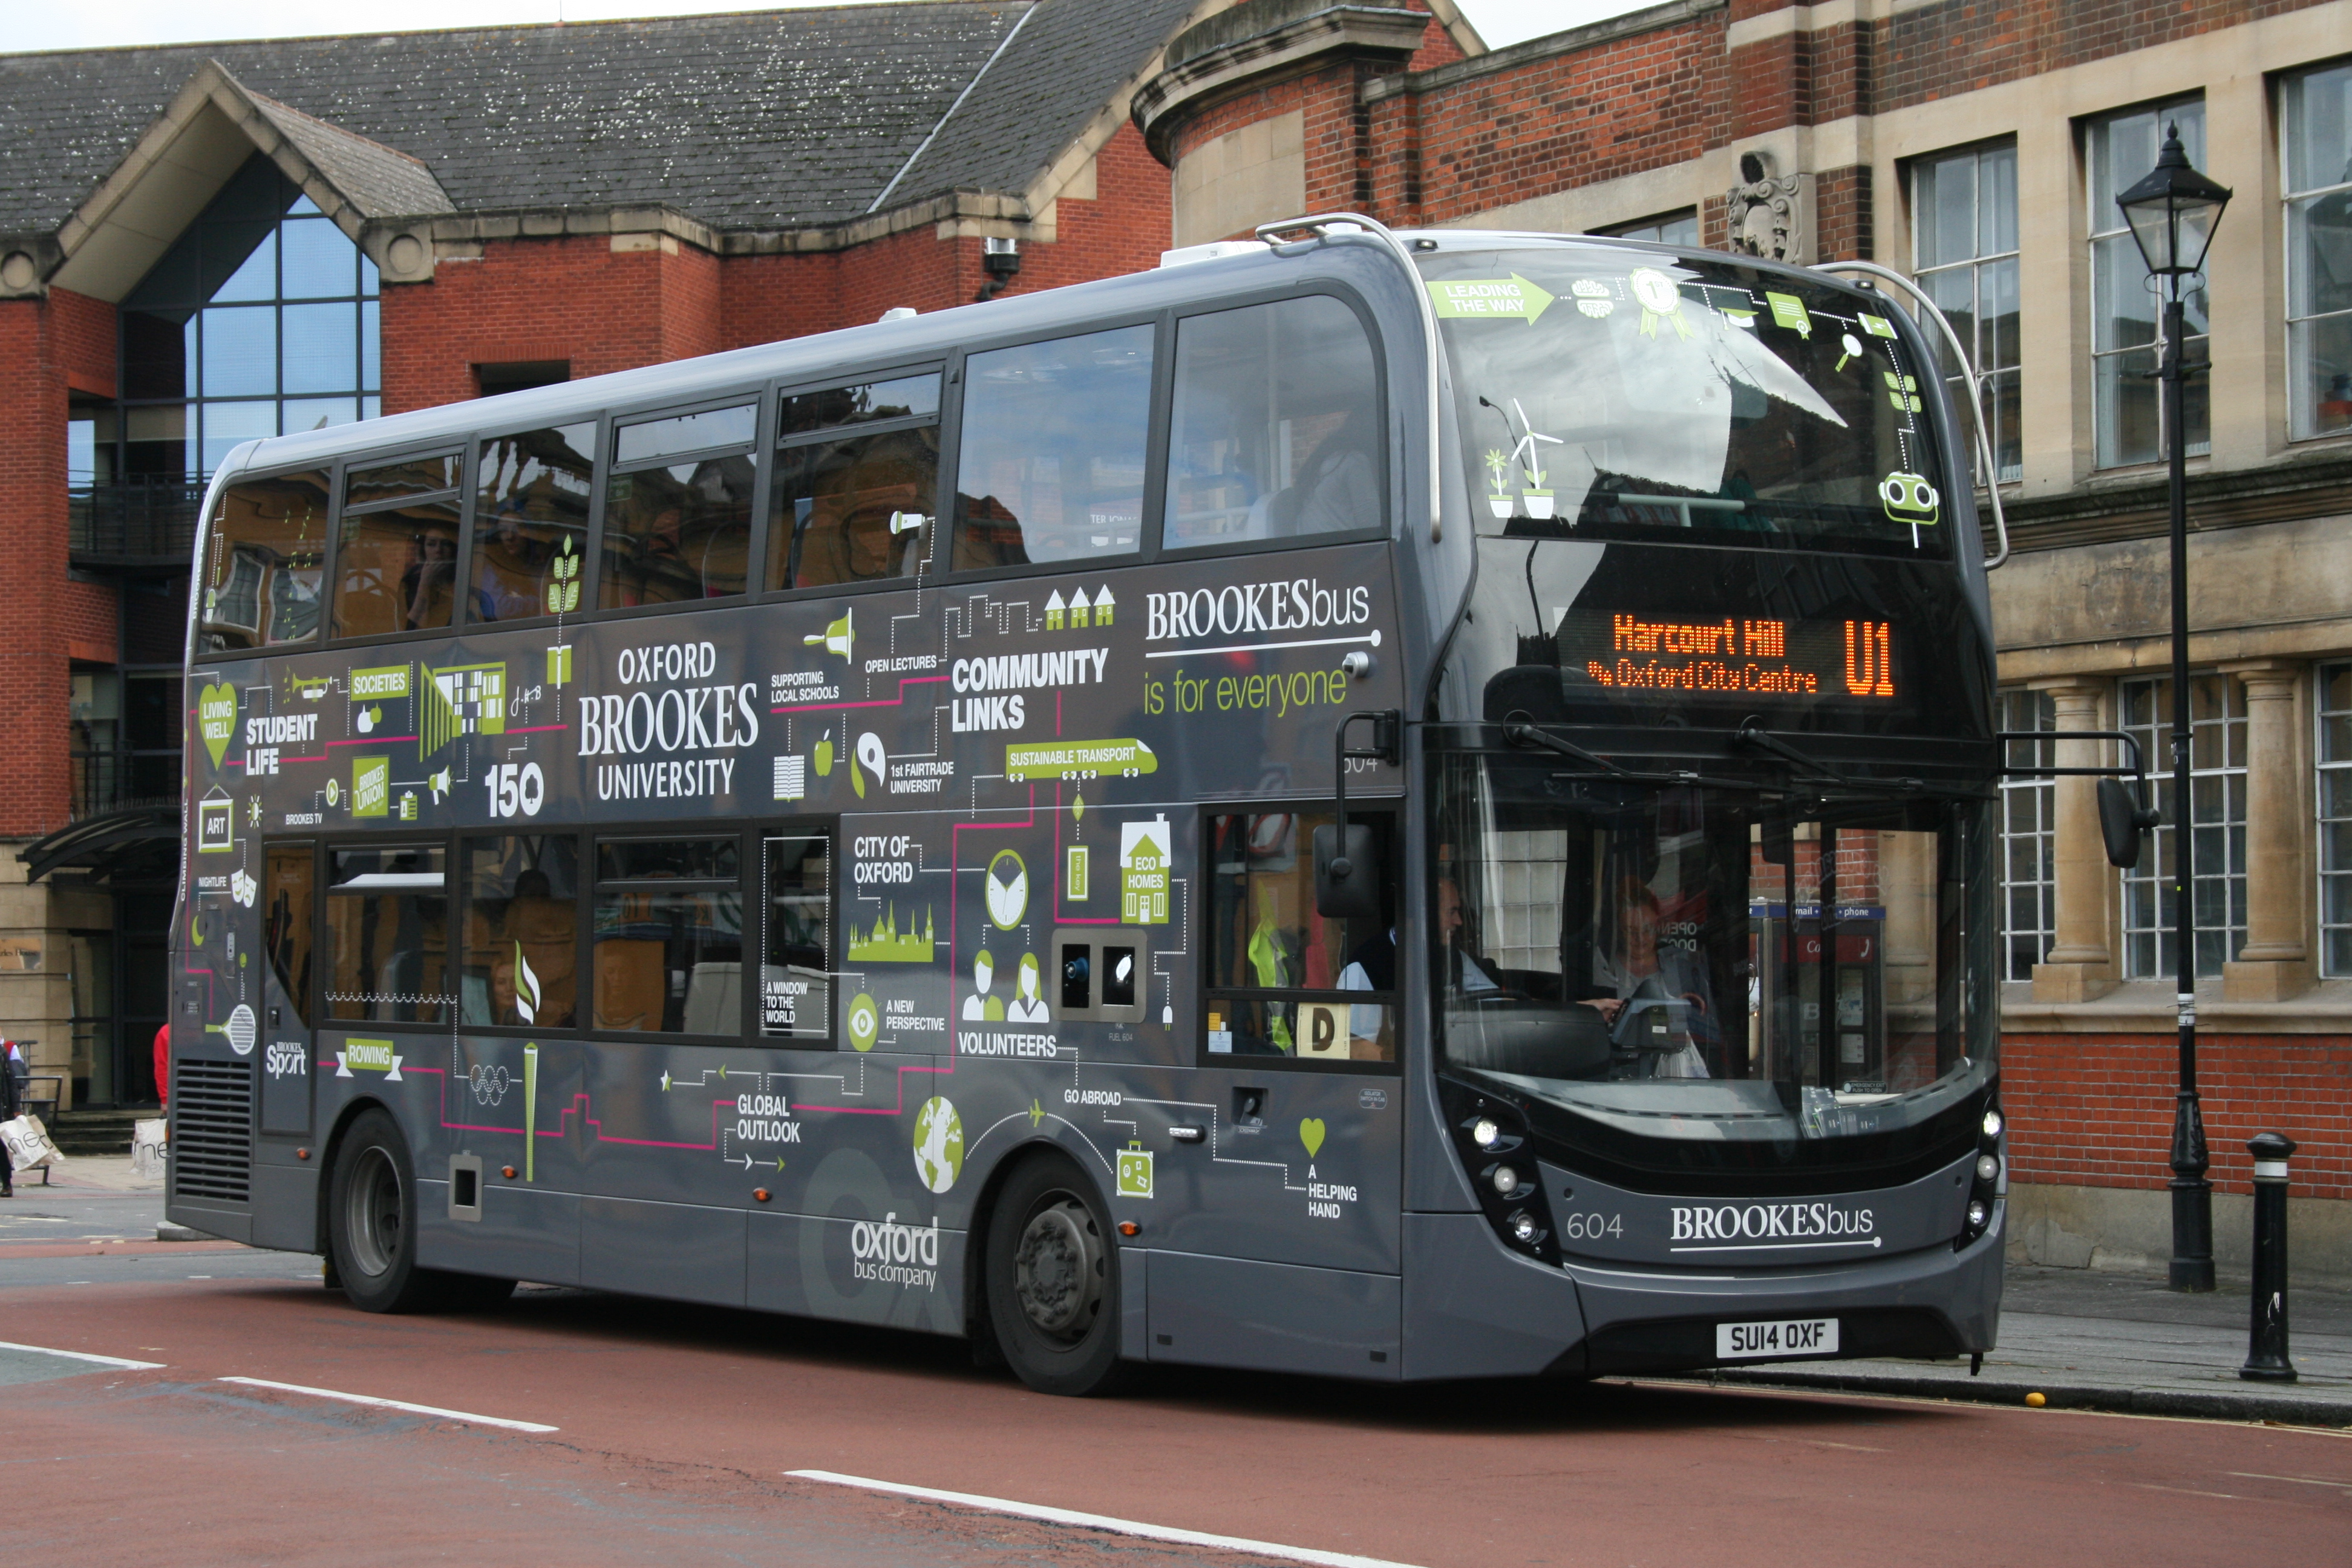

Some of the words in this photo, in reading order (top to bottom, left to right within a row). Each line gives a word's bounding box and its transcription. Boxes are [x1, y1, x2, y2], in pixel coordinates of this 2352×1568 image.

[1445, 284, 1521, 297] LEADING
[1449, 299, 1488, 312] THE
[1488, 299, 1524, 312] WAY
[1146, 578, 1369, 640] BROOKESbus
[1614, 614, 1736, 655] Harcourt
[1745, 619, 1783, 657] Hill
[618, 642, 716, 684] OXFORD
[865, 658, 889, 673] OPEN
[891, 655, 936, 671] LECTURES
[1846, 621, 1893, 695] U1
[771, 671, 824, 688] SUPPORTING
[952, 648, 1109, 693] COMMUNITY
[1618, 658, 1693, 688] Oxford
[1698, 662, 1740, 690] City
[1745, 664, 1815, 693] Centre
[354, 672, 405, 694] SOCIETIES
[771, 688, 798, 703] LOCAL
[800, 685, 839, 701] SCHOOLS
[1145, 673, 1165, 714] is
[1174, 670, 1209, 713] for
[1217, 668, 1347, 717] everyone
[203, 701, 232, 719] LIVING
[578, 682, 759, 756] BROOKES
[952, 694, 1025, 732] LINKS
[204, 721, 230, 739] WELL
[246, 713, 318, 745] STUDENT
[246, 748, 279, 776] LIFE
[1010, 749, 1074, 766] SUSTAINABLE
[1077, 746, 1135, 763] TRANSPORT
[359, 764, 385, 792] BROOKES
[598, 758, 734, 800] UNIVERSITY
[890, 765, 904, 777] 1st
[905, 761, 954, 777] FAIRTRADE
[354, 781, 384, 810] UNION
[485, 762, 544, 817] 150
[890, 778, 942, 794] UNIVERSITY
[207, 817, 226, 834] ART
[286, 812, 313, 825] BROOKES
[314, 812, 322, 825] TV
[854, 836, 887, 858] CITY
[890, 835, 910, 857] OF
[854, 861, 913, 883] OXFORD
[1135, 857, 1156, 871] ECO
[198, 877, 227, 887] NIGHTLIFE
[1128, 874, 1163, 889] HOMES
[1844, 907, 1869, 916] phone
[766, 982, 772, 995] A
[773, 982, 808, 995] WINDOW
[766, 996, 776, 1009] TO
[777, 996, 794, 1009] THE
[886, 1000, 892, 1013] A
[894, 1000, 915, 1013] NEW
[766, 1011, 795, 1024] WORLD
[886, 1016, 945, 1031] PERSPECTIVE
[1312, 1007, 1335, 1051] D
[276, 1041, 302, 1053] BROOKES
[348, 1044, 390, 1065] ROWING
[958, 1032, 1057, 1057] VOLUNTEERS
[266, 1045, 306, 1080] Sport
[737, 1094, 790, 1117] GLOBAL
[1064, 1089, 1079, 1103] GO
[1080, 1090, 1121, 1106] ABROAD
[737, 1119, 801, 1143] OUTLOOK
[1308, 1164, 1316, 1179] A
[1308, 1183, 1357, 1201] HELPING
[1308, 1202, 1341, 1218] HAND
[1671, 1202, 1873, 1240] BROOKESbus
[1566, 1212, 1624, 1240] 604
[852, 1212, 938, 1266] oxford
[854, 1257, 877, 1279] bus
[879, 1261, 936, 1292] company
[1731, 1325, 1779, 1351] SU14
[1786, 1322, 1826, 1348] OXF
